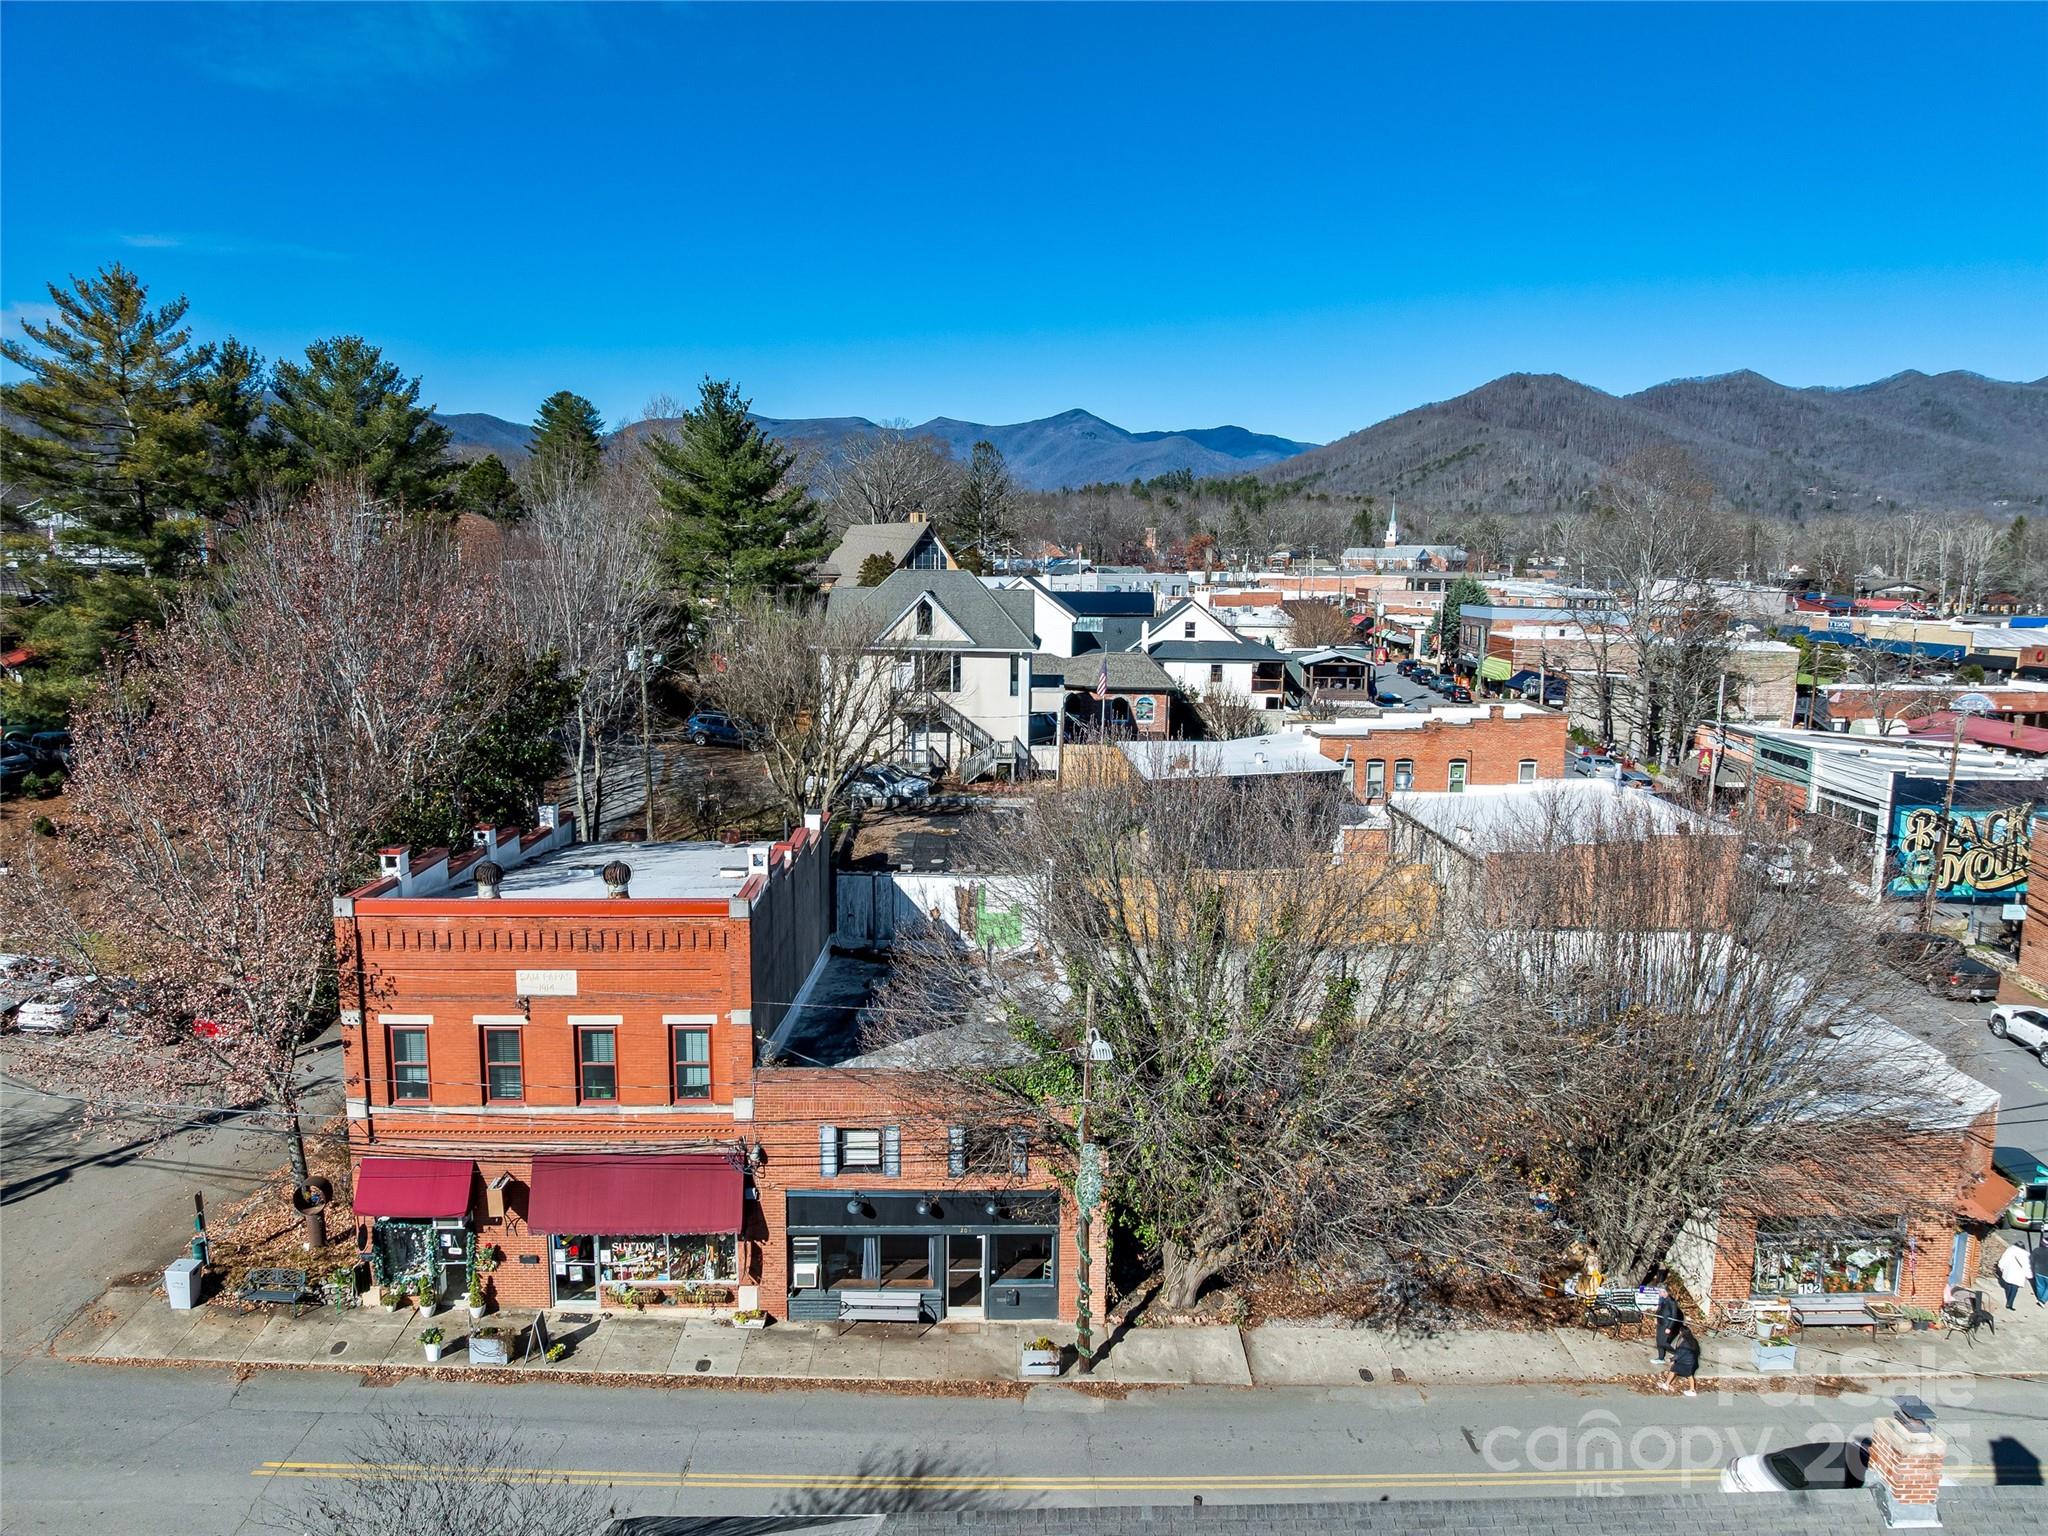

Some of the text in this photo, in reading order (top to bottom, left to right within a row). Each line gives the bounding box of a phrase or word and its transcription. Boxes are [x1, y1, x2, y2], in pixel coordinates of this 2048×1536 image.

[1901, 802, 2031, 852] BLACK
[611, 1242, 655, 1253] SUTTON
[1798, 1283, 1821, 1294] 132
